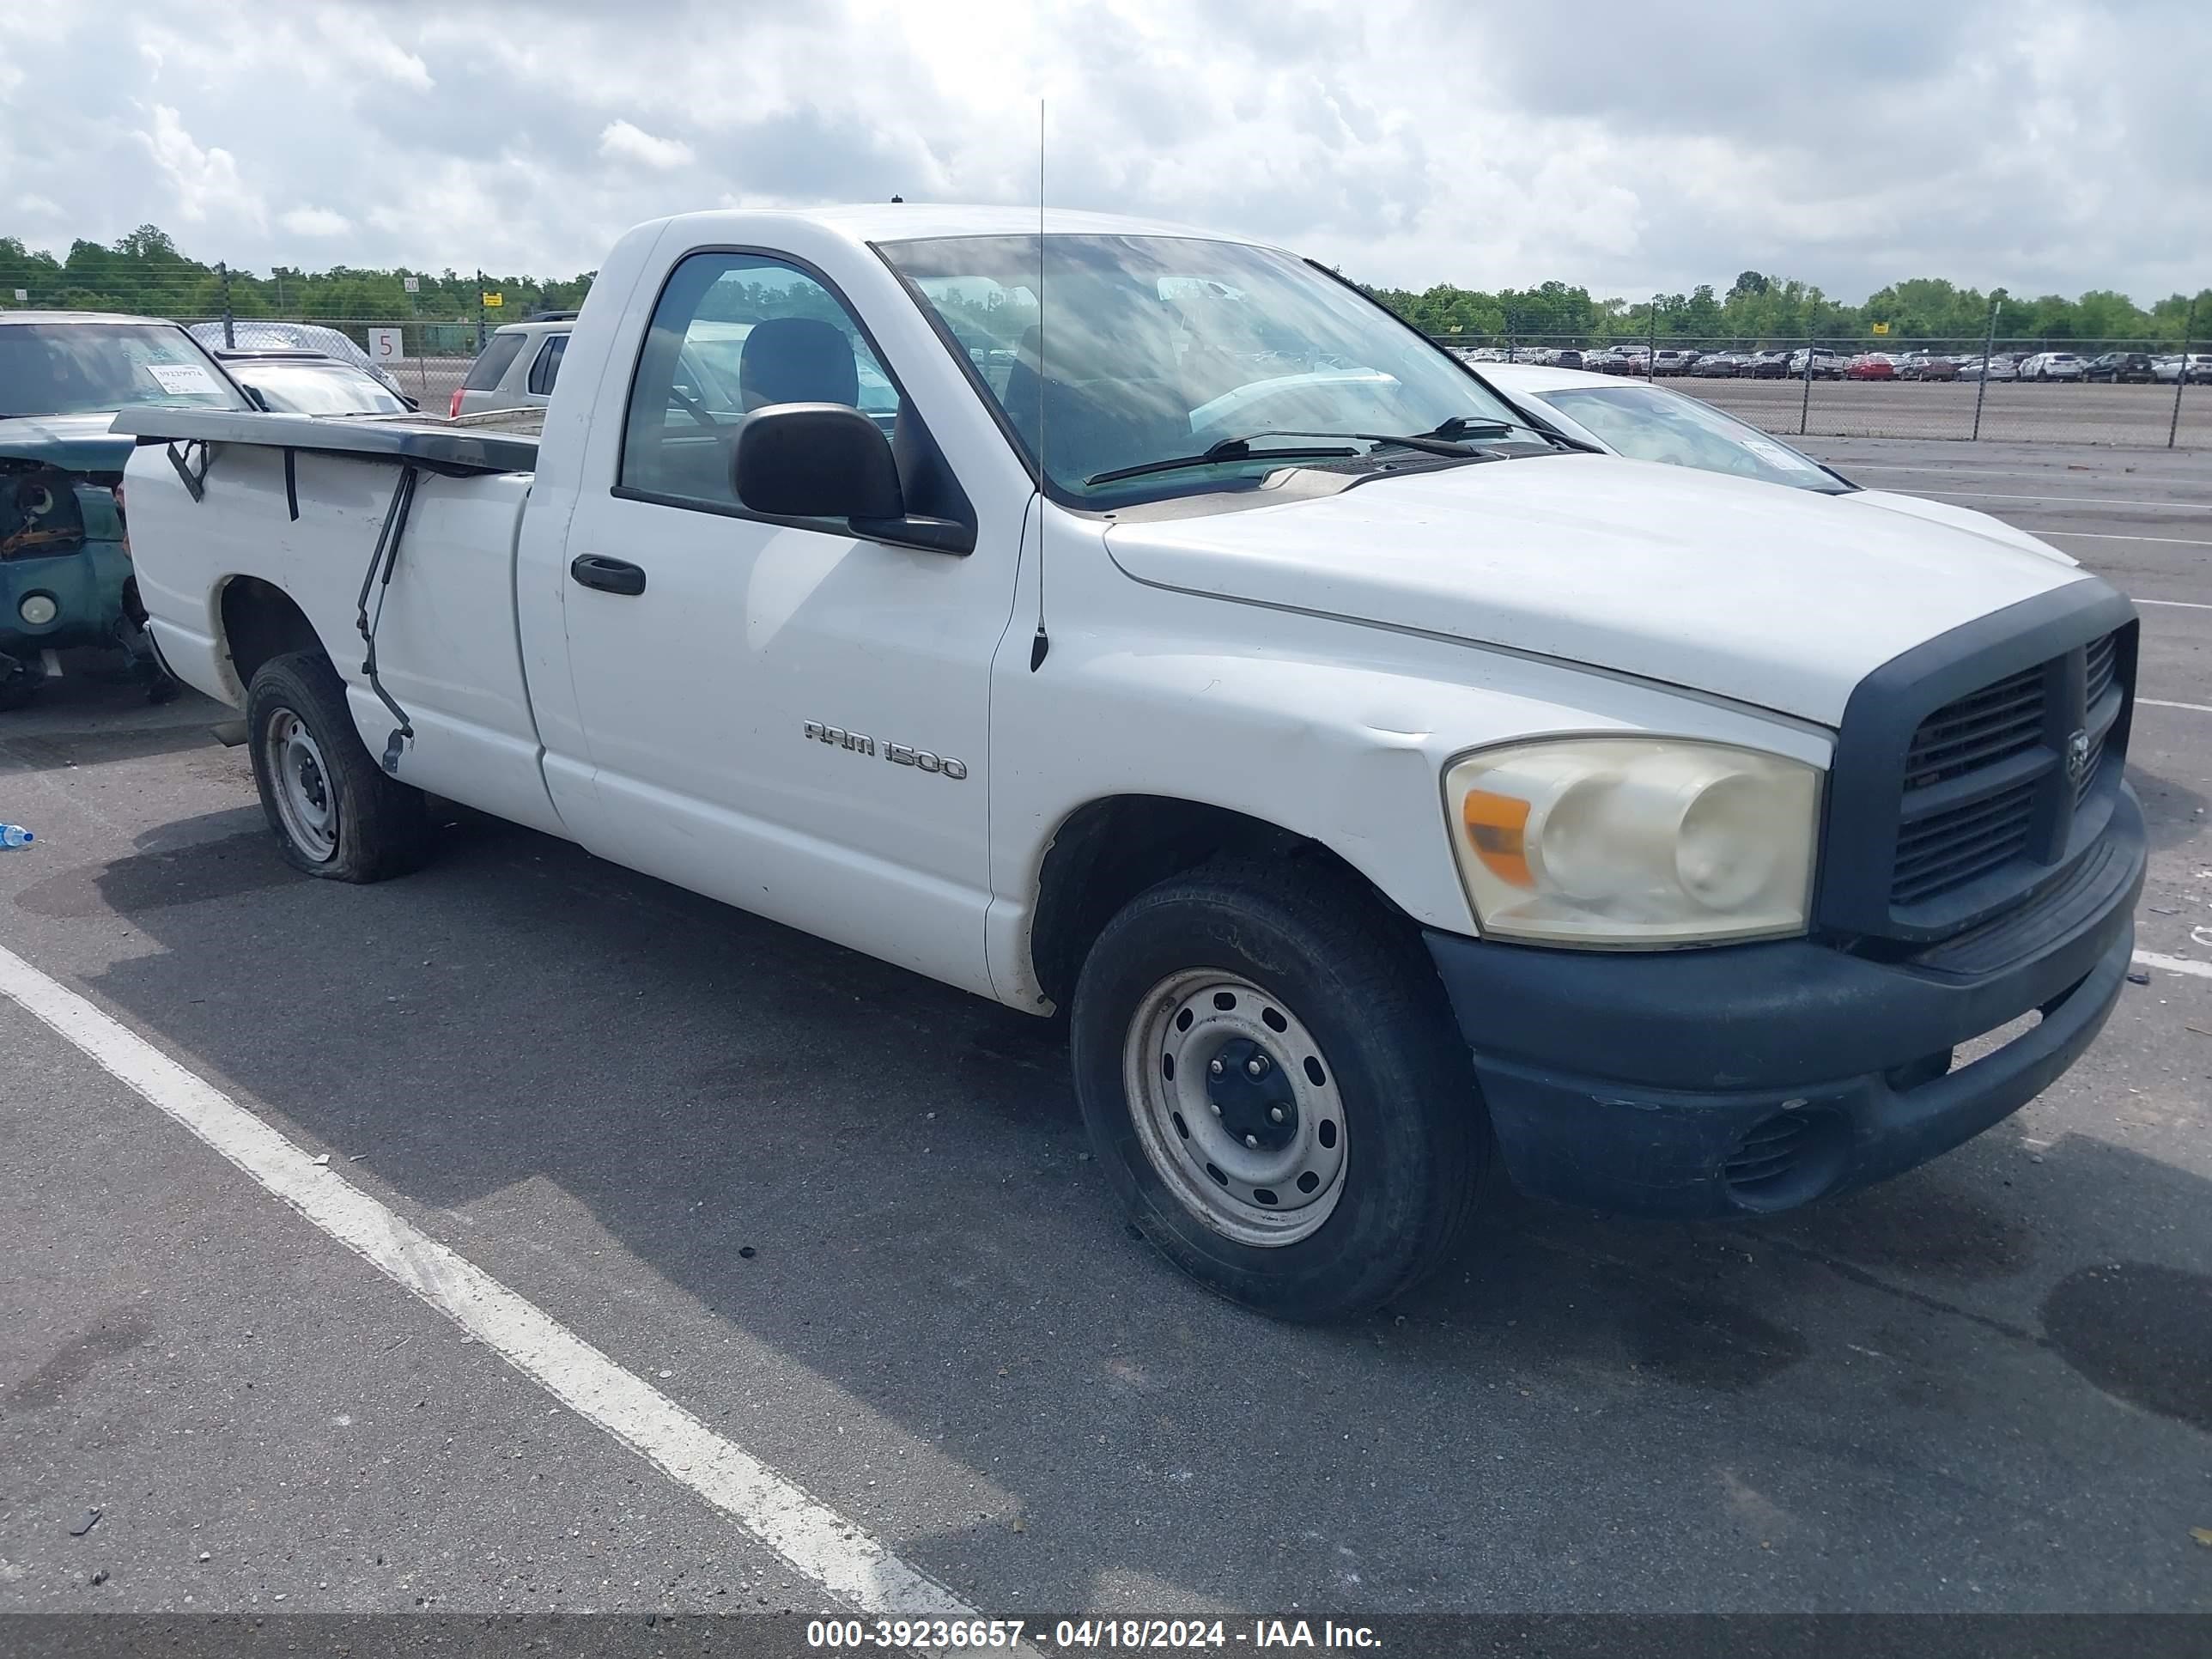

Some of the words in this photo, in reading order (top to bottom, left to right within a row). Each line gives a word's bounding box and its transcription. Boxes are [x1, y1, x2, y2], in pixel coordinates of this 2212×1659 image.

[405, 280, 418, 290] 20
[380, 335, 392, 356] 5
[804, 718, 875, 757] RAM
[882, 739, 968, 781] 1500
